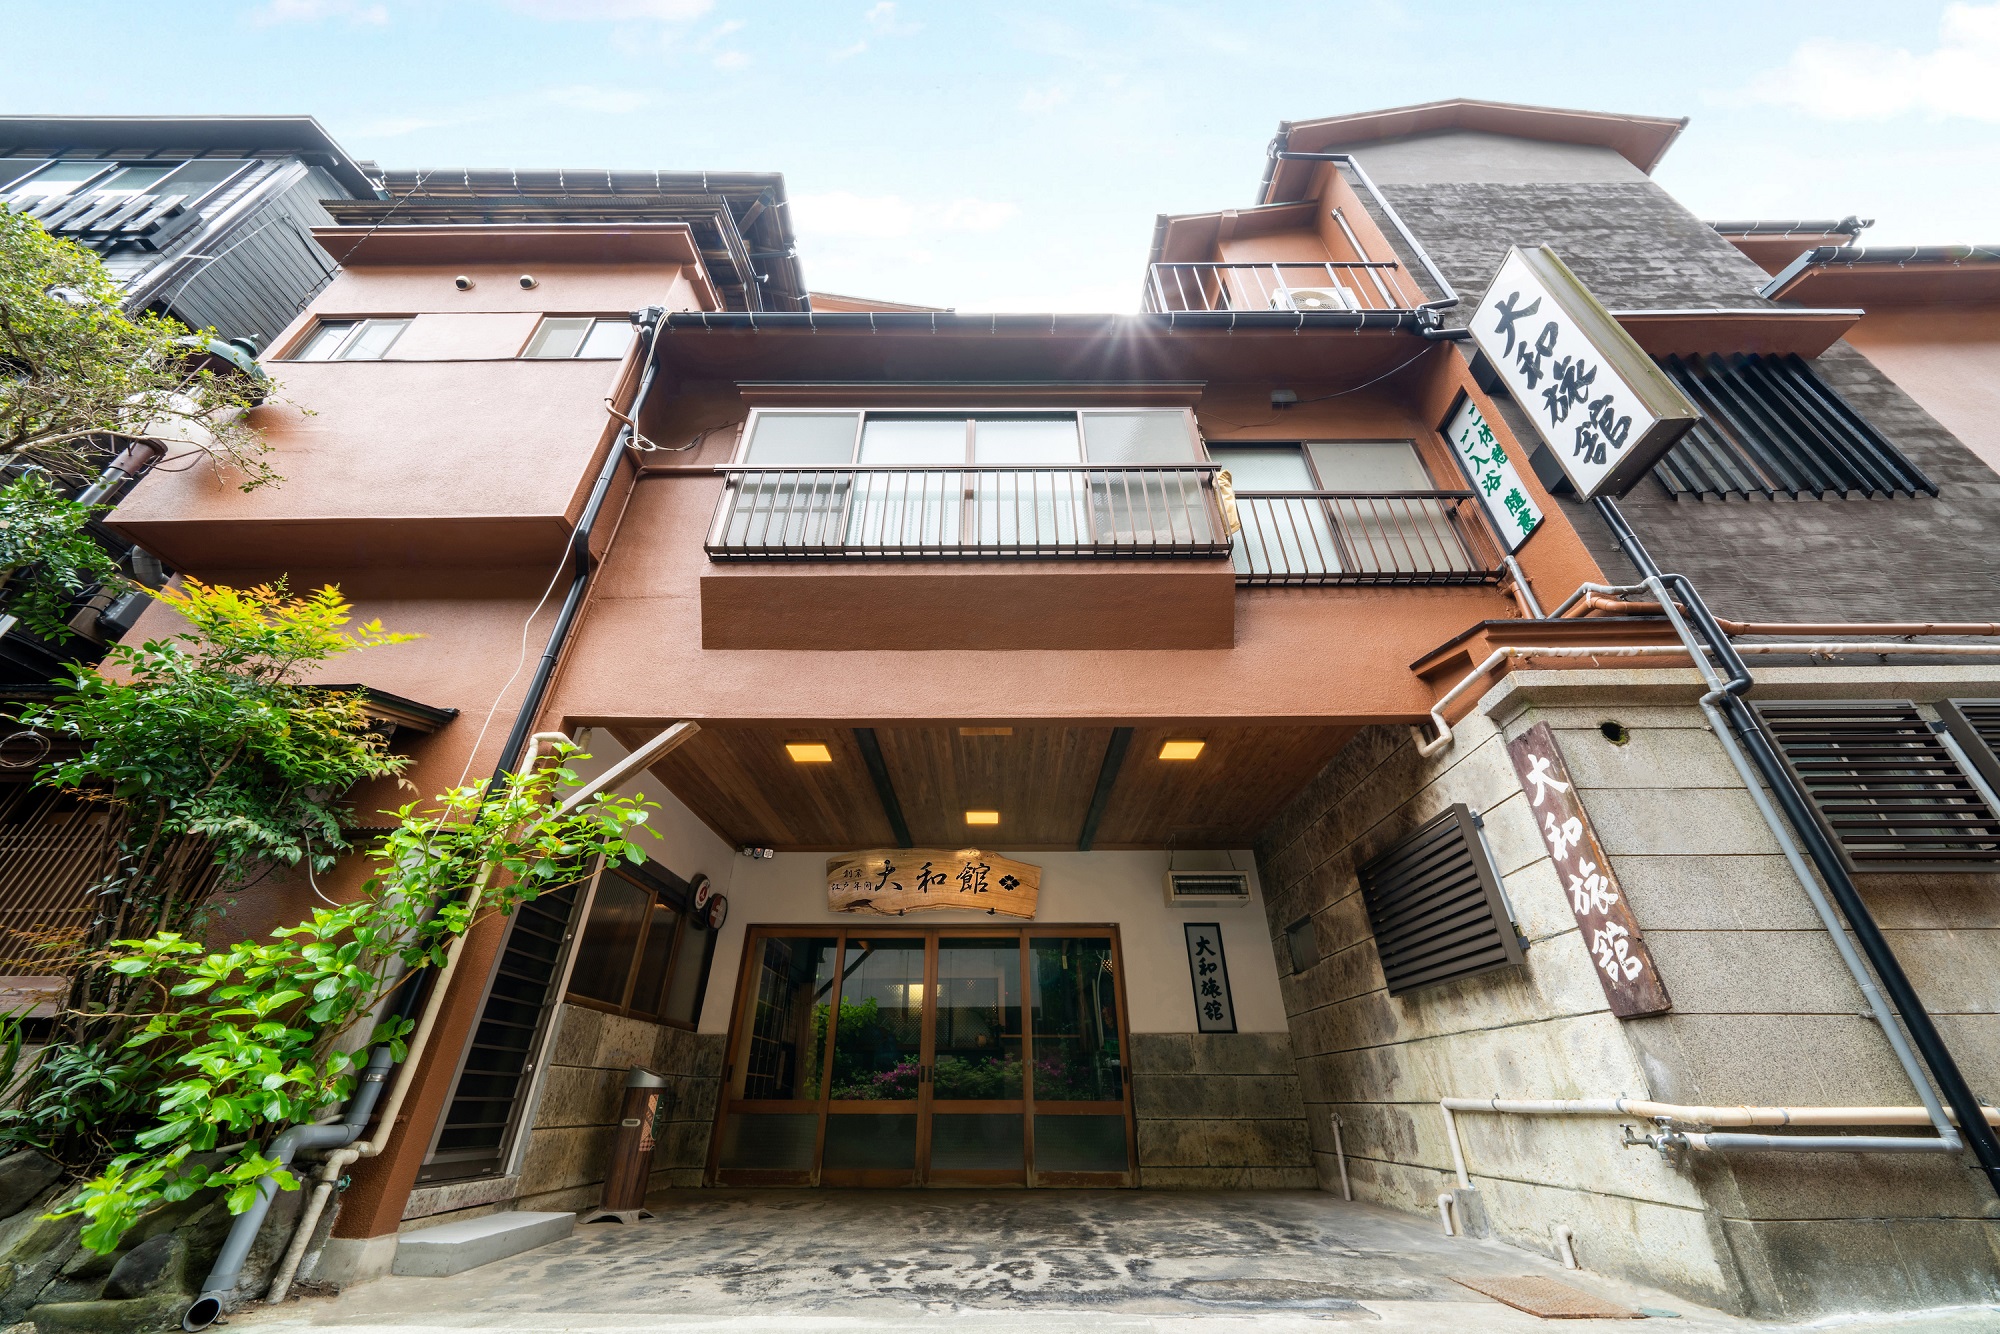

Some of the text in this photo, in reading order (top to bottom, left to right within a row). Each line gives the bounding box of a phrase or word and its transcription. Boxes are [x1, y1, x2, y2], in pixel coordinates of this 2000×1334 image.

[1460, 428, 1503, 497] ご入浴
[831, 881, 872, 891] 江戸年間
[875, 859, 991, 895] 大和館
